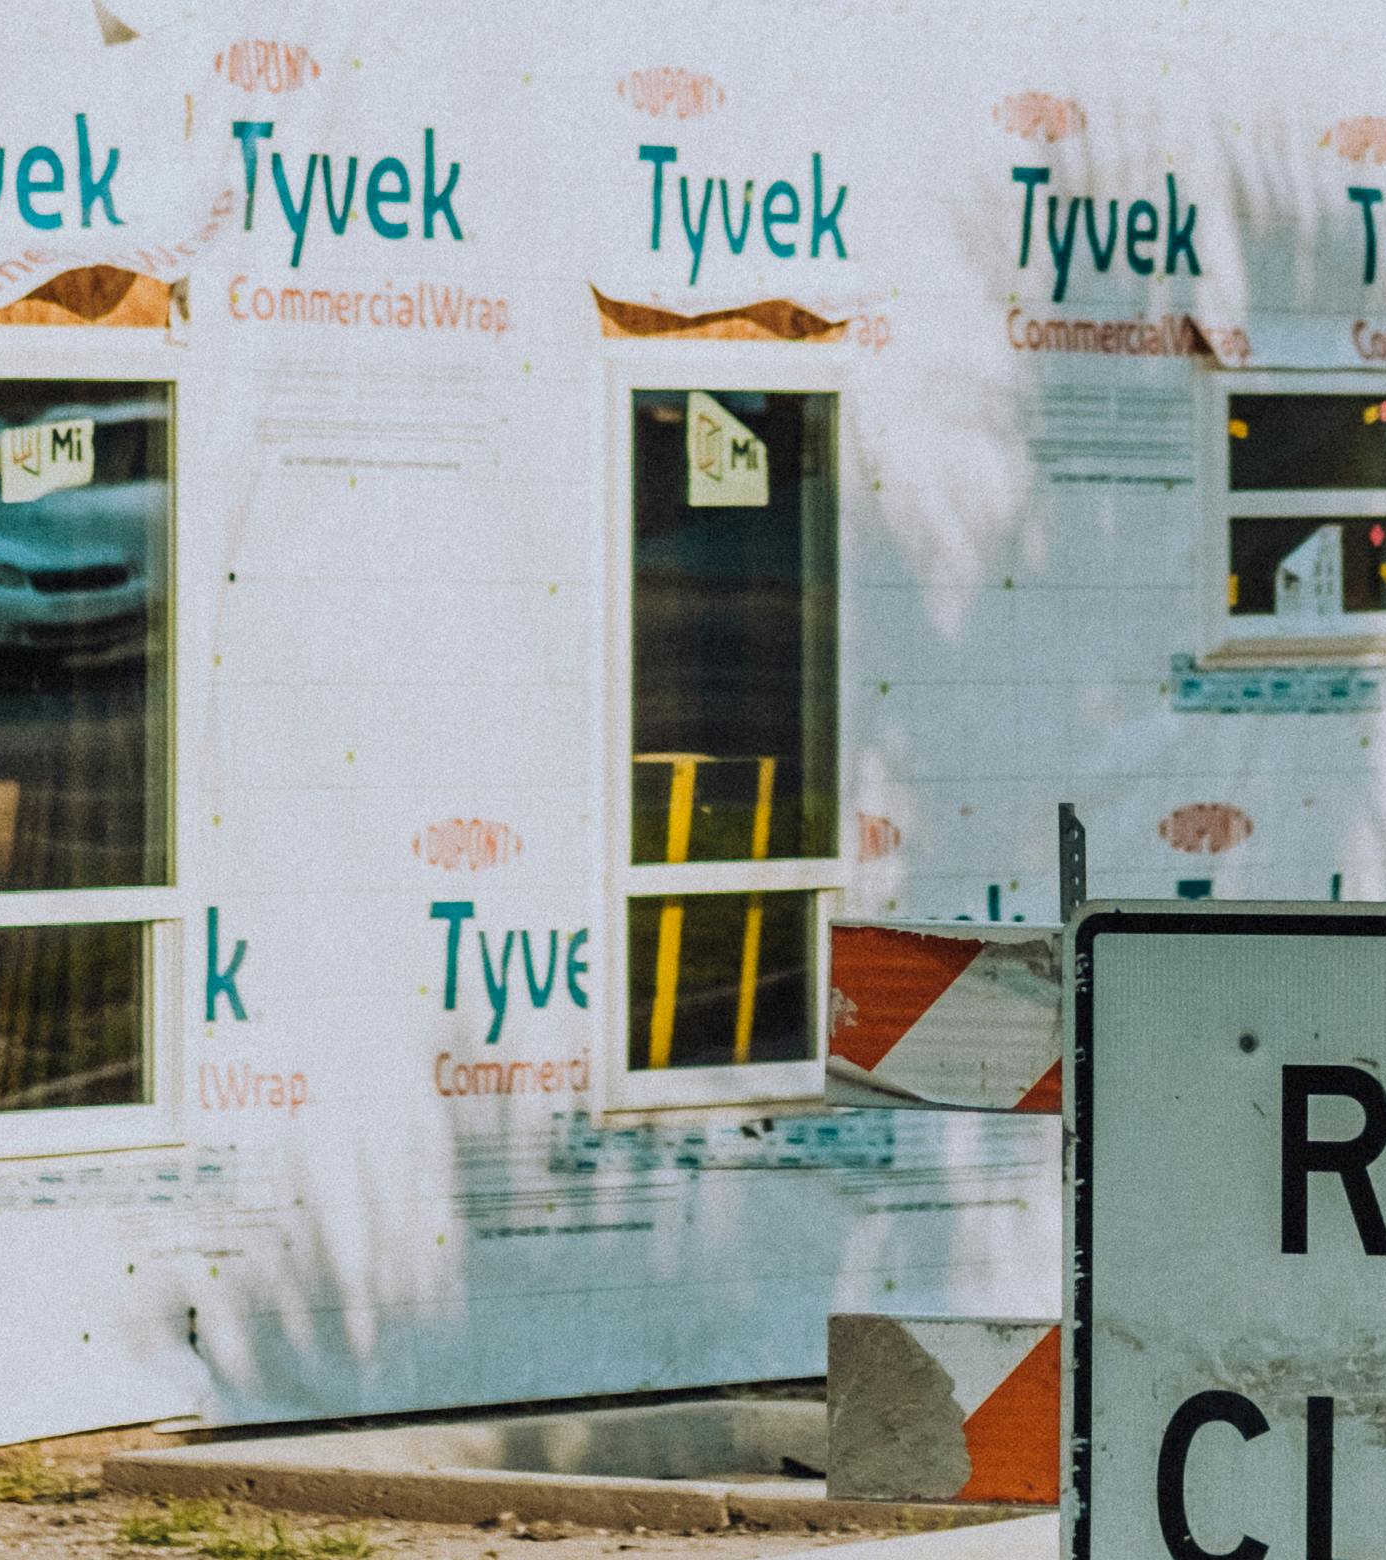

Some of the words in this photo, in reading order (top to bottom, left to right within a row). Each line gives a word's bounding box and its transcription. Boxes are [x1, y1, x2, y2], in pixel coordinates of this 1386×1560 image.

[232, 121, 464, 268] Tyvek
[639, 146, 846, 285] Tyvek
[1013, 167, 1201, 302] Tyvek
[230, 275, 510, 340] CommercialWrap
[50, 427, 83, 465] Mi
[730, 436, 759, 471] Mi
